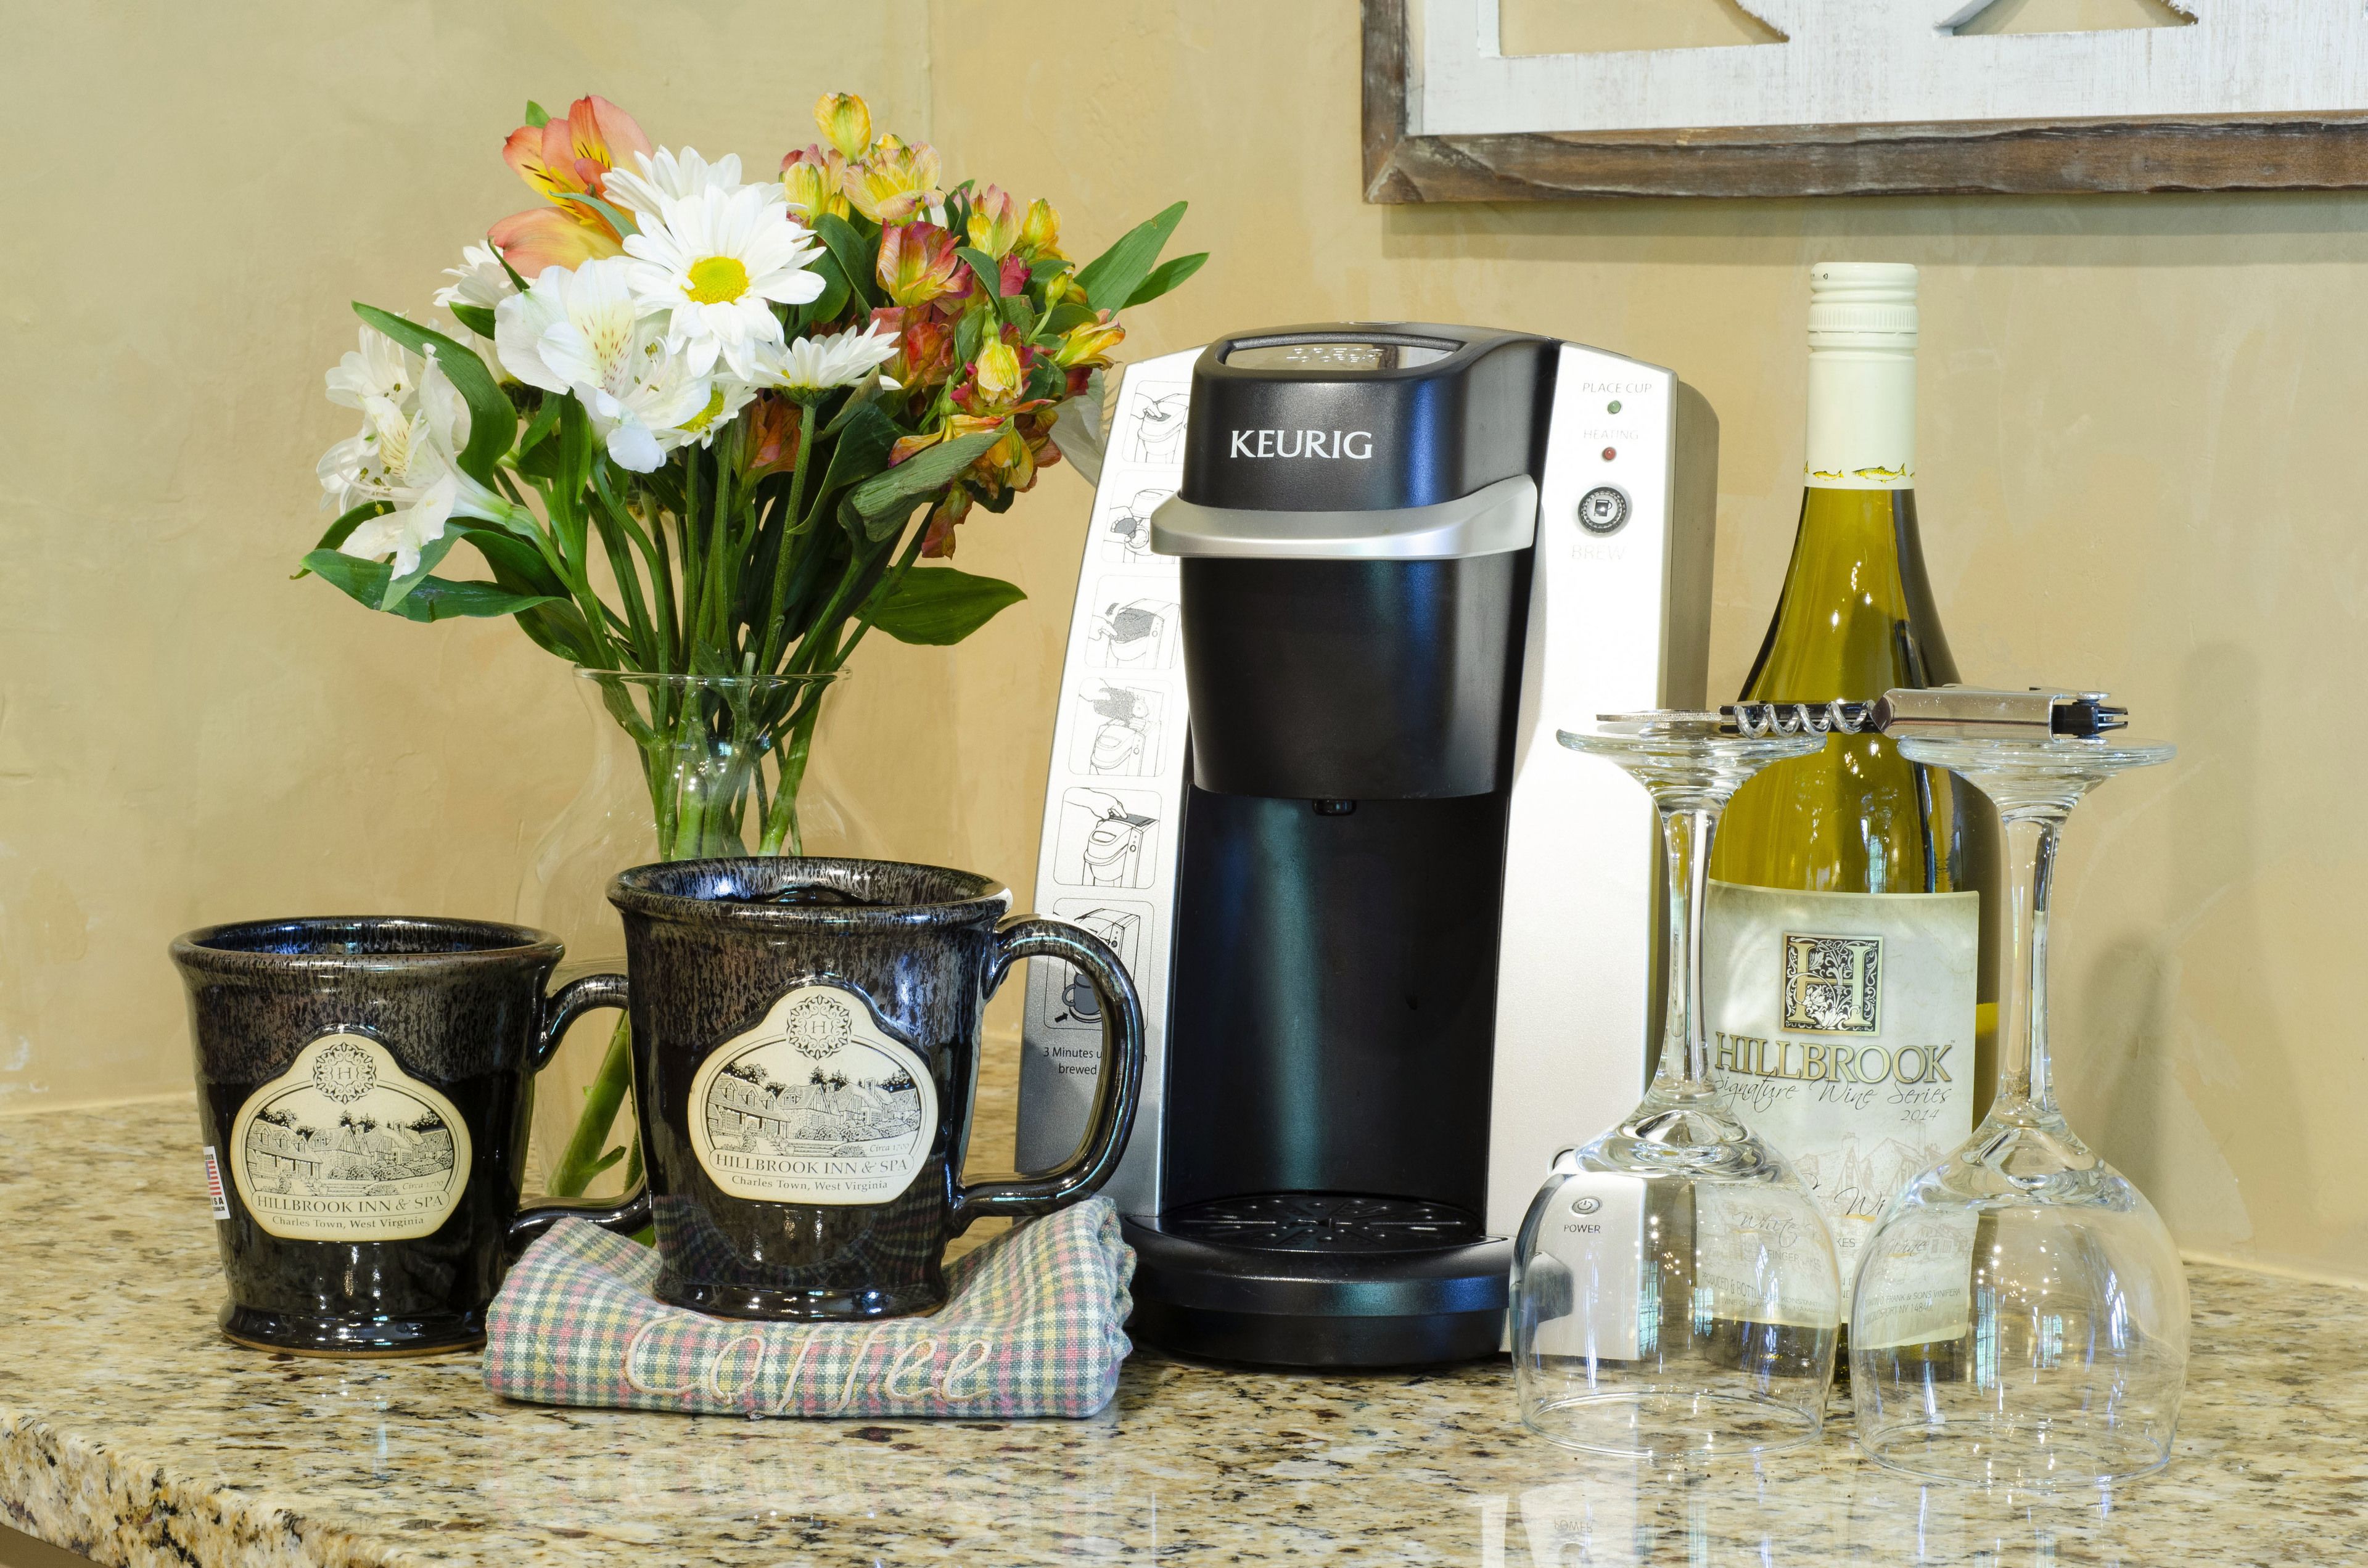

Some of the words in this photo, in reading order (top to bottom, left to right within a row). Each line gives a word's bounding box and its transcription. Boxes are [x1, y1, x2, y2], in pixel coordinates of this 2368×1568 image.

[1582, 382, 1622, 393] PLACE
[1626, 382, 1653, 393] CUP
[1583, 429, 1639, 440] HEATING
[1230, 430, 1373, 459] KEURIG
[1571, 544, 1627, 560] BREW
[811, 1021, 827, 1034] H
[1043, 1047, 1049, 1057] 3
[1052, 1047, 1093, 1058] Minutes
[1715, 1031, 1952, 1085] HILLBROOK
[337, 1067, 352, 1080] H
[1058, 1063, 1097, 1075] brewed
[1715, 1064, 1799, 1113] Signature
[1809, 1078, 1878, 1110] Wine
[1886, 1075, 1952, 1104] Series
[1900, 1109, 1940, 1122] 2014
[869, 1144, 890, 1152] Circa
[893, 1143, 910, 1152] 1700
[715, 1154, 818, 1174] HILLBROOK
[823, 1162, 857, 1174] INN
[861, 1161, 876, 1173] &
[879, 1159, 908, 1173] SPA
[402, 1183, 423, 1191] Circa
[731, 1175, 773, 1188] Charles
[776, 1180, 811, 1191] Town,
[815, 1181, 841, 1191] West
[844, 1180, 888, 1192] Virginia
[257, 1195, 352, 1213] HILLBROOK
[359, 1200, 391, 1213] INN
[395, 1198, 411, 1210] &
[414, 1195, 445, 1210] SPA
[1834, 1186, 1886, 1217] Wi
[272, 1215, 310, 1228] Charles
[314, 1218, 346, 1229] Town,
[350, 1220, 376, 1229] West
[379, 1217, 424, 1229] Virginia
[1564, 1224, 1601, 1234] POWER
[1767, 1249, 1800, 1262] FINGER
[1913, 1290, 1932, 1300] SONS
[1933, 1288, 1961, 1298] VINIFERA
[1899, 1304, 1909, 1314] NY
[623, 1311, 994, 1421] Coffee
